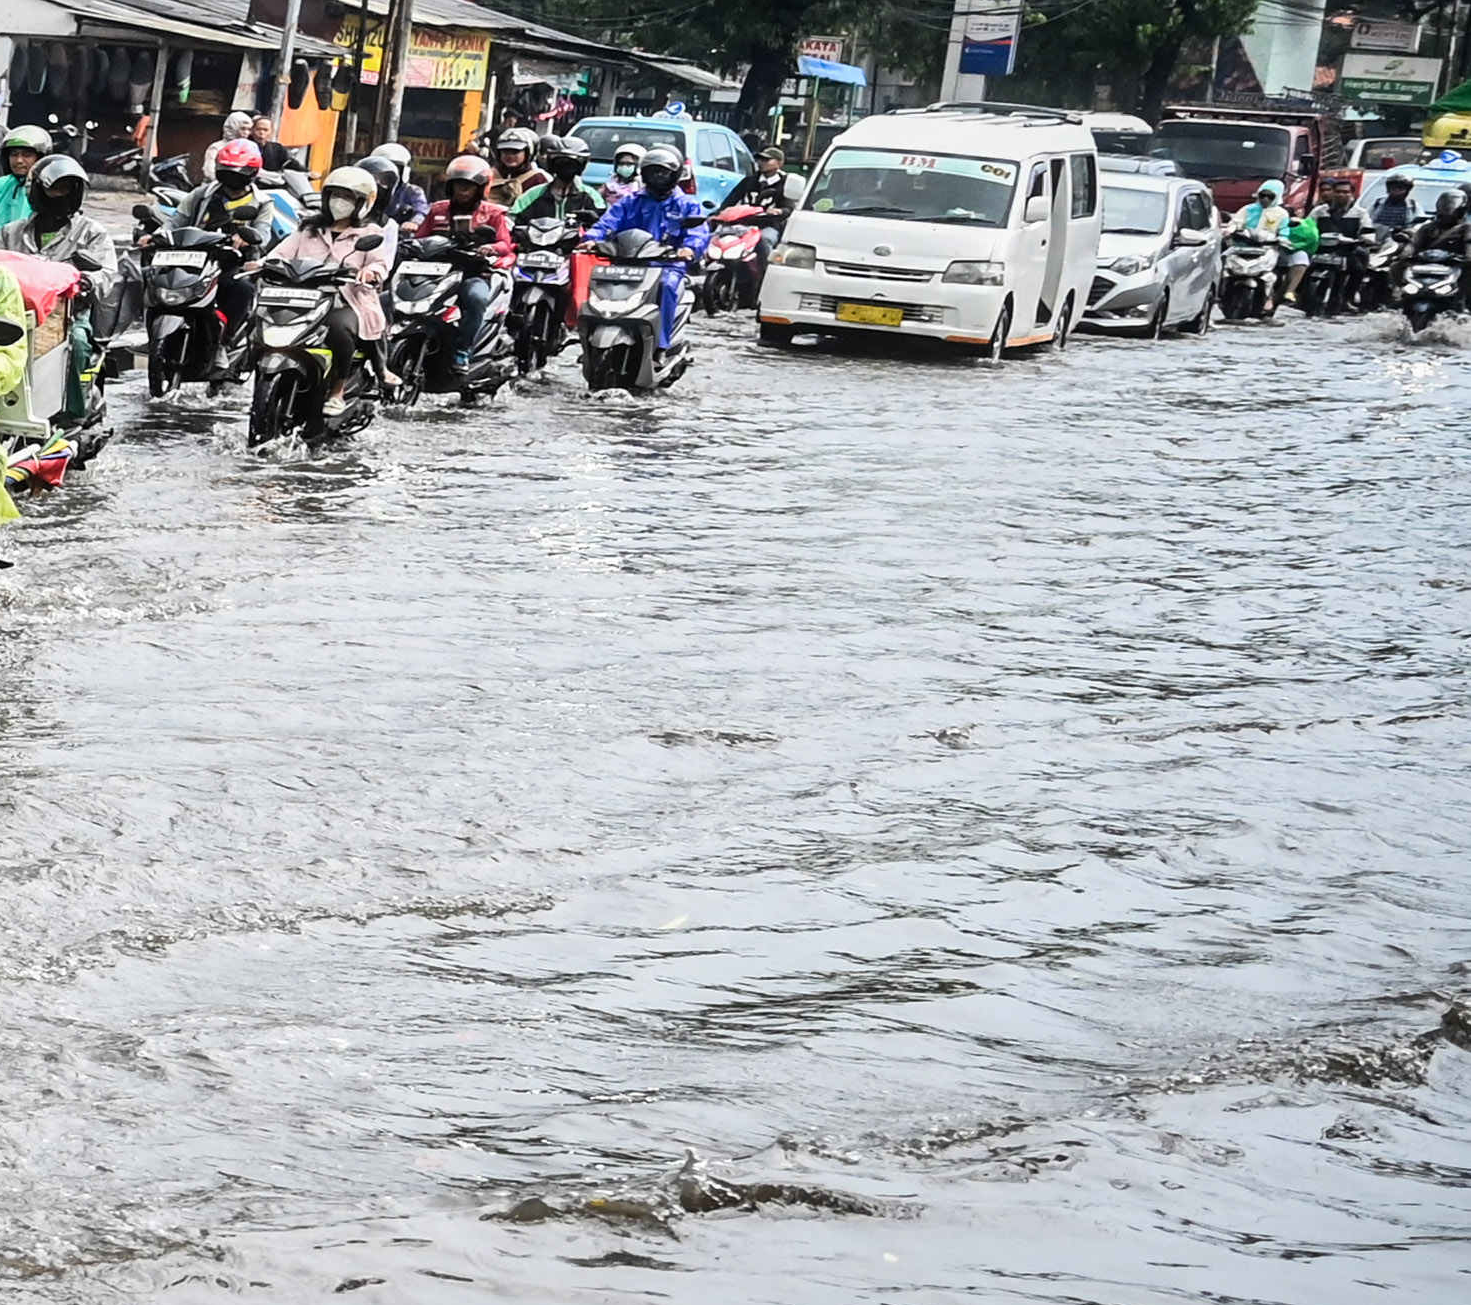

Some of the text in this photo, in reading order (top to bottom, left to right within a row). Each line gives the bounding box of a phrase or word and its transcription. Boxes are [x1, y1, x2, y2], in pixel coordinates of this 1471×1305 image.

[1344, 80, 1431, 94] Herbal & Terapi
[899, 155, 937, 168] BM
